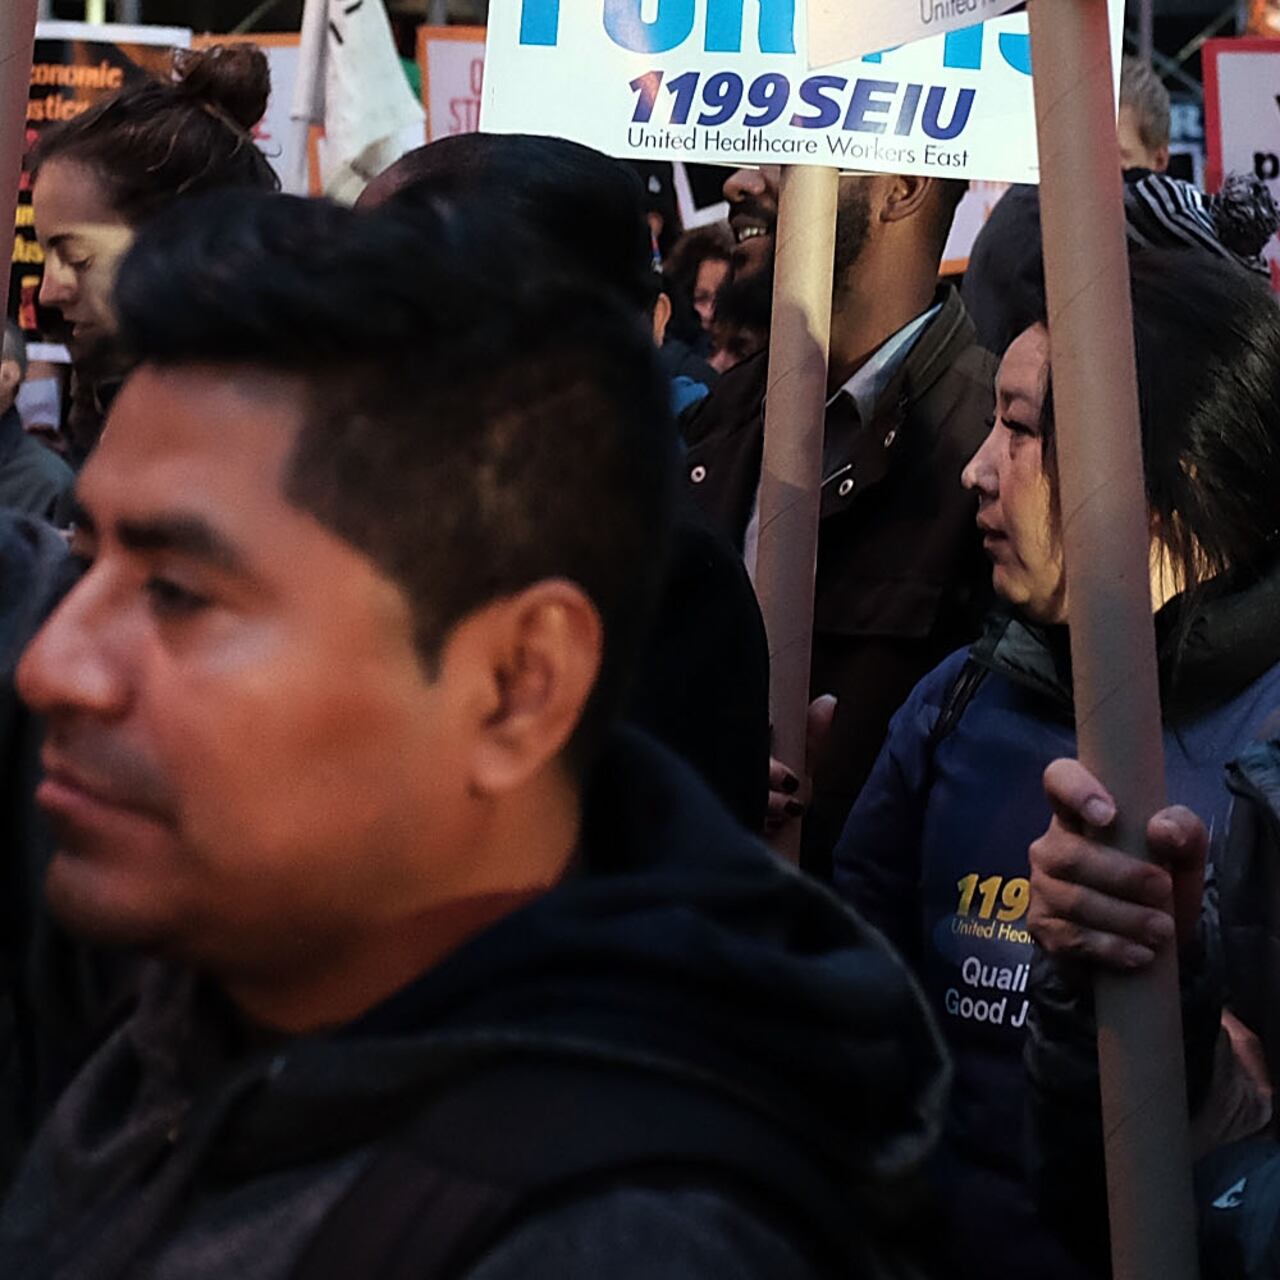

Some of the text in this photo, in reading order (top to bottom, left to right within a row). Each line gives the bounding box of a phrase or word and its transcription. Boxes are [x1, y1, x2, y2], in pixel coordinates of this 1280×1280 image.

[629, 71, 976, 140] 1199SEIU
[627, 127, 970, 168] United Healthcare Workers East
[951, 918, 996, 939] United
[945, 988, 1008, 1024] Good
